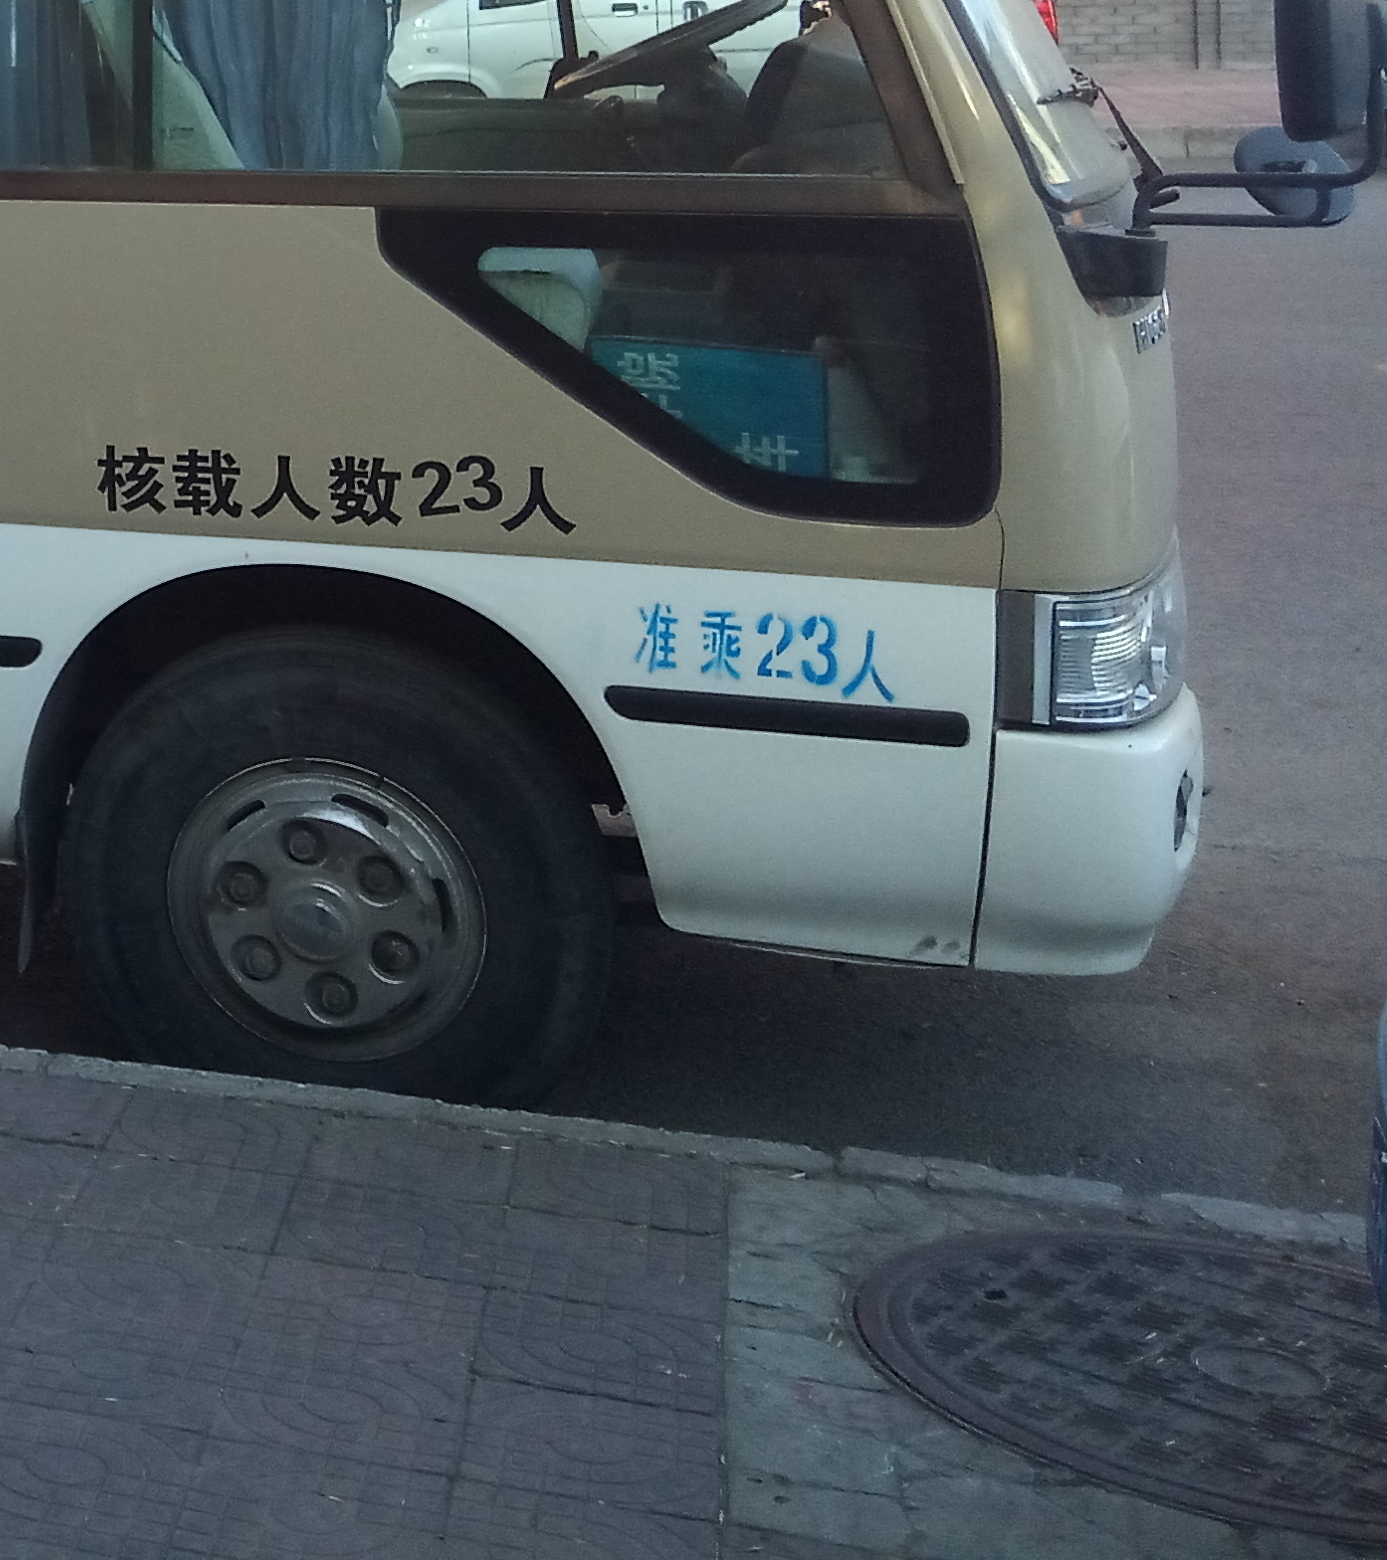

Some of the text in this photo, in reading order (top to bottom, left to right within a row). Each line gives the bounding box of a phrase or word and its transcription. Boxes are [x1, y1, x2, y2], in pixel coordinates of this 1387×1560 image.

[96, 444, 577, 536] 核载人数23人
[633, 602, 895, 703] 准乘23人
